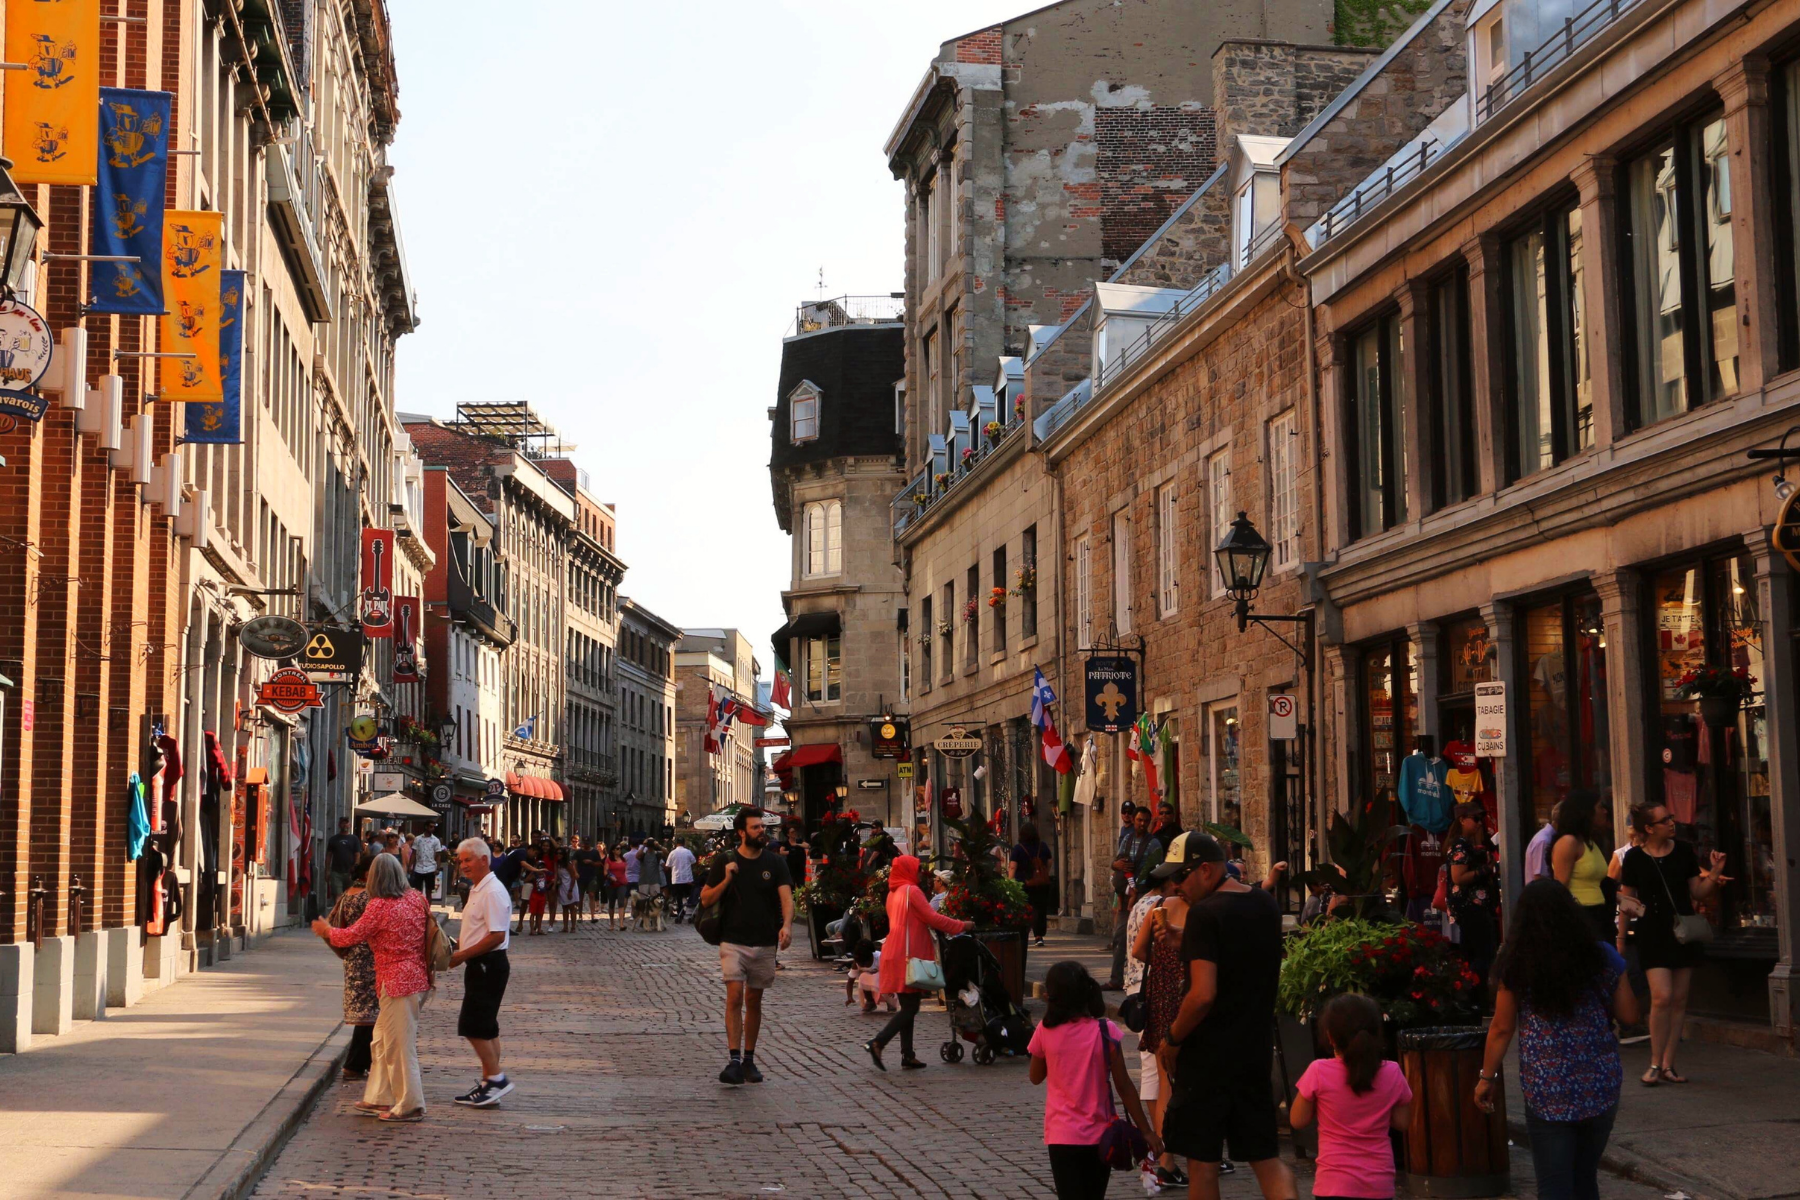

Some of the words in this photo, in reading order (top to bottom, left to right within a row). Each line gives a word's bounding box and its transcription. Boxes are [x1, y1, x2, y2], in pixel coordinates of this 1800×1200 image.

[298, 662, 345, 670] TUDIOSAPOLLO
[272, 670, 307, 684] MONTREAL
[1088, 671, 1132, 680] PATRIOTE
[271, 686, 306, 698] KEBAB
[1477, 704, 1504, 715] TABAGIE
[1477, 741, 1504, 751] CUBAINS
[899, 766, 912, 774] ATM
